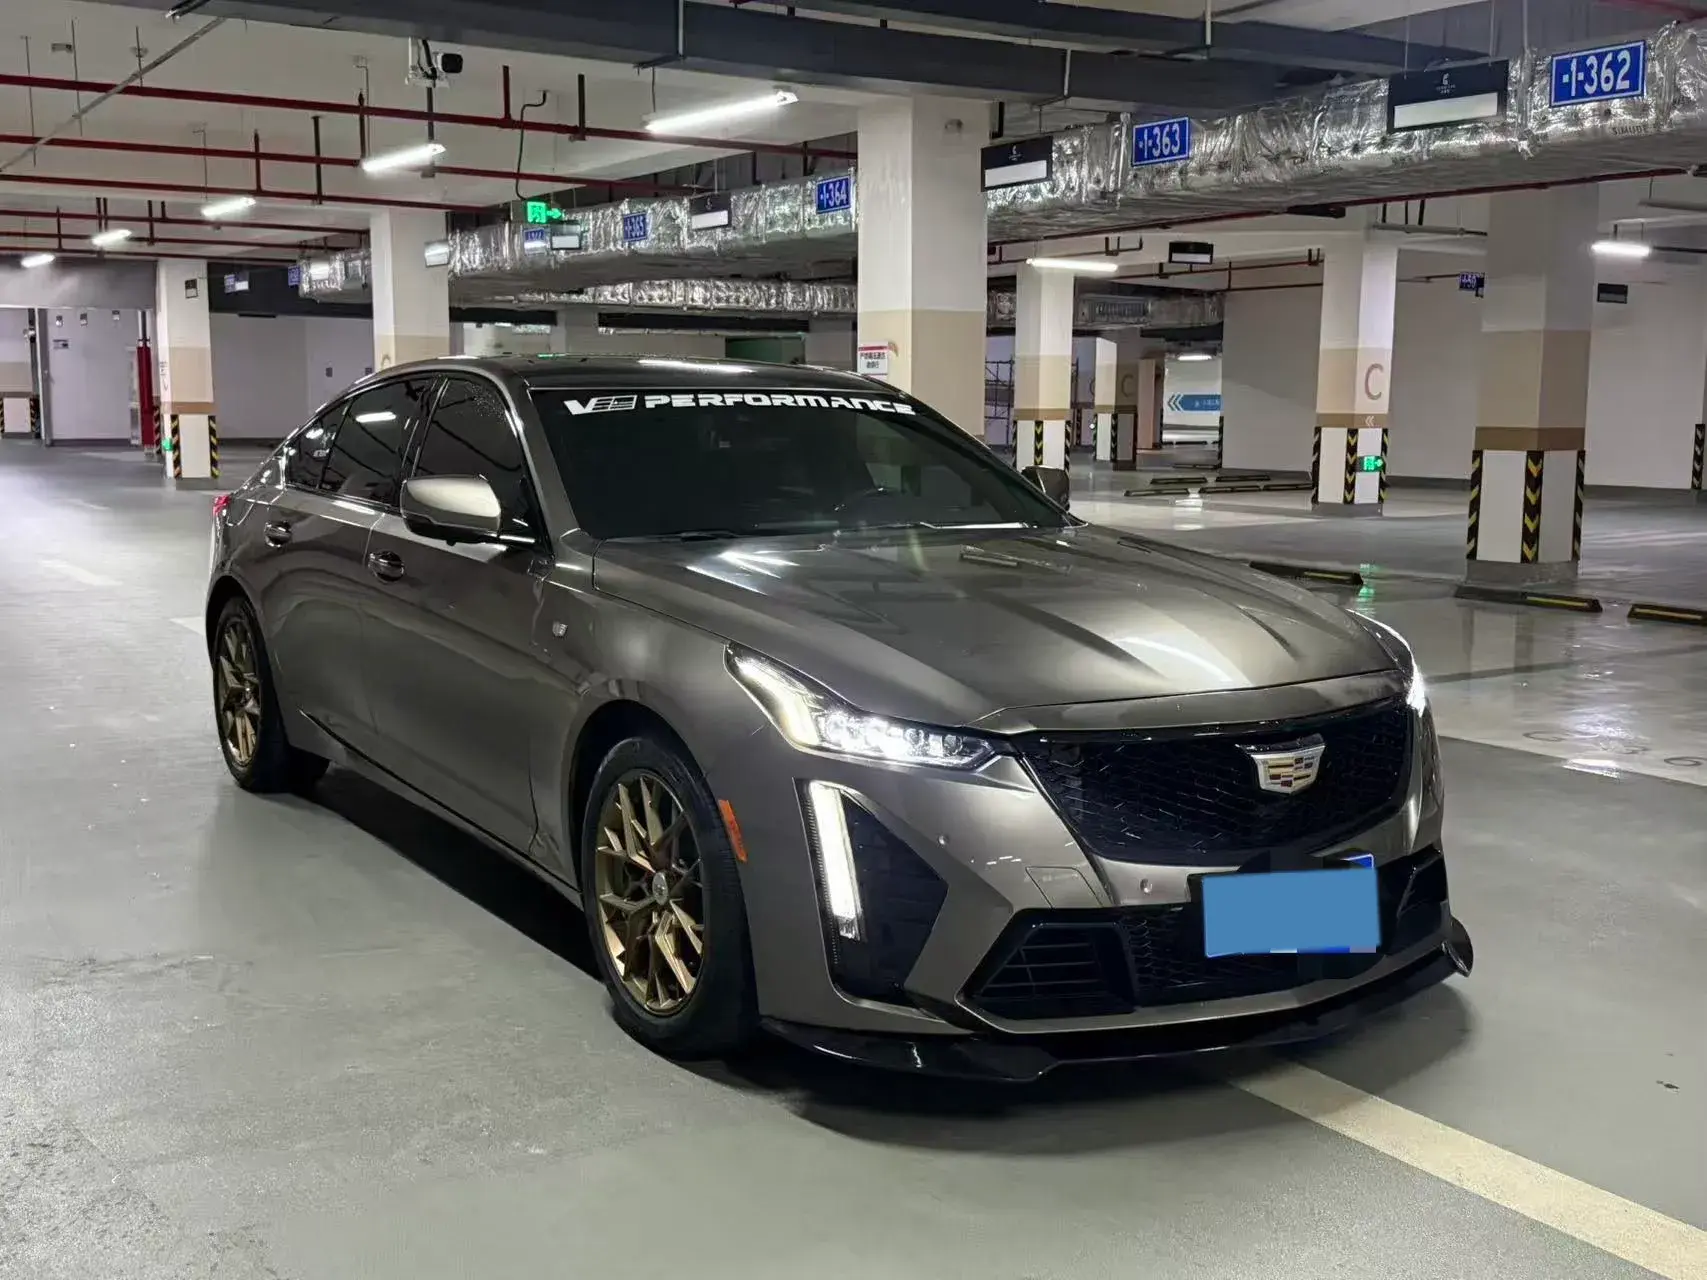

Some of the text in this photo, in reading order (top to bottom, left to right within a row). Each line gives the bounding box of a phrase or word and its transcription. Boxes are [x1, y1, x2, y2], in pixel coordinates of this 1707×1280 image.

[1562, 50, 1631, 97] -1-362
[1138, 123, 1181, 159] -1-363
[1364, 363, 1384, 401] C
[645, 393, 916, 416] PERFORMANCE
